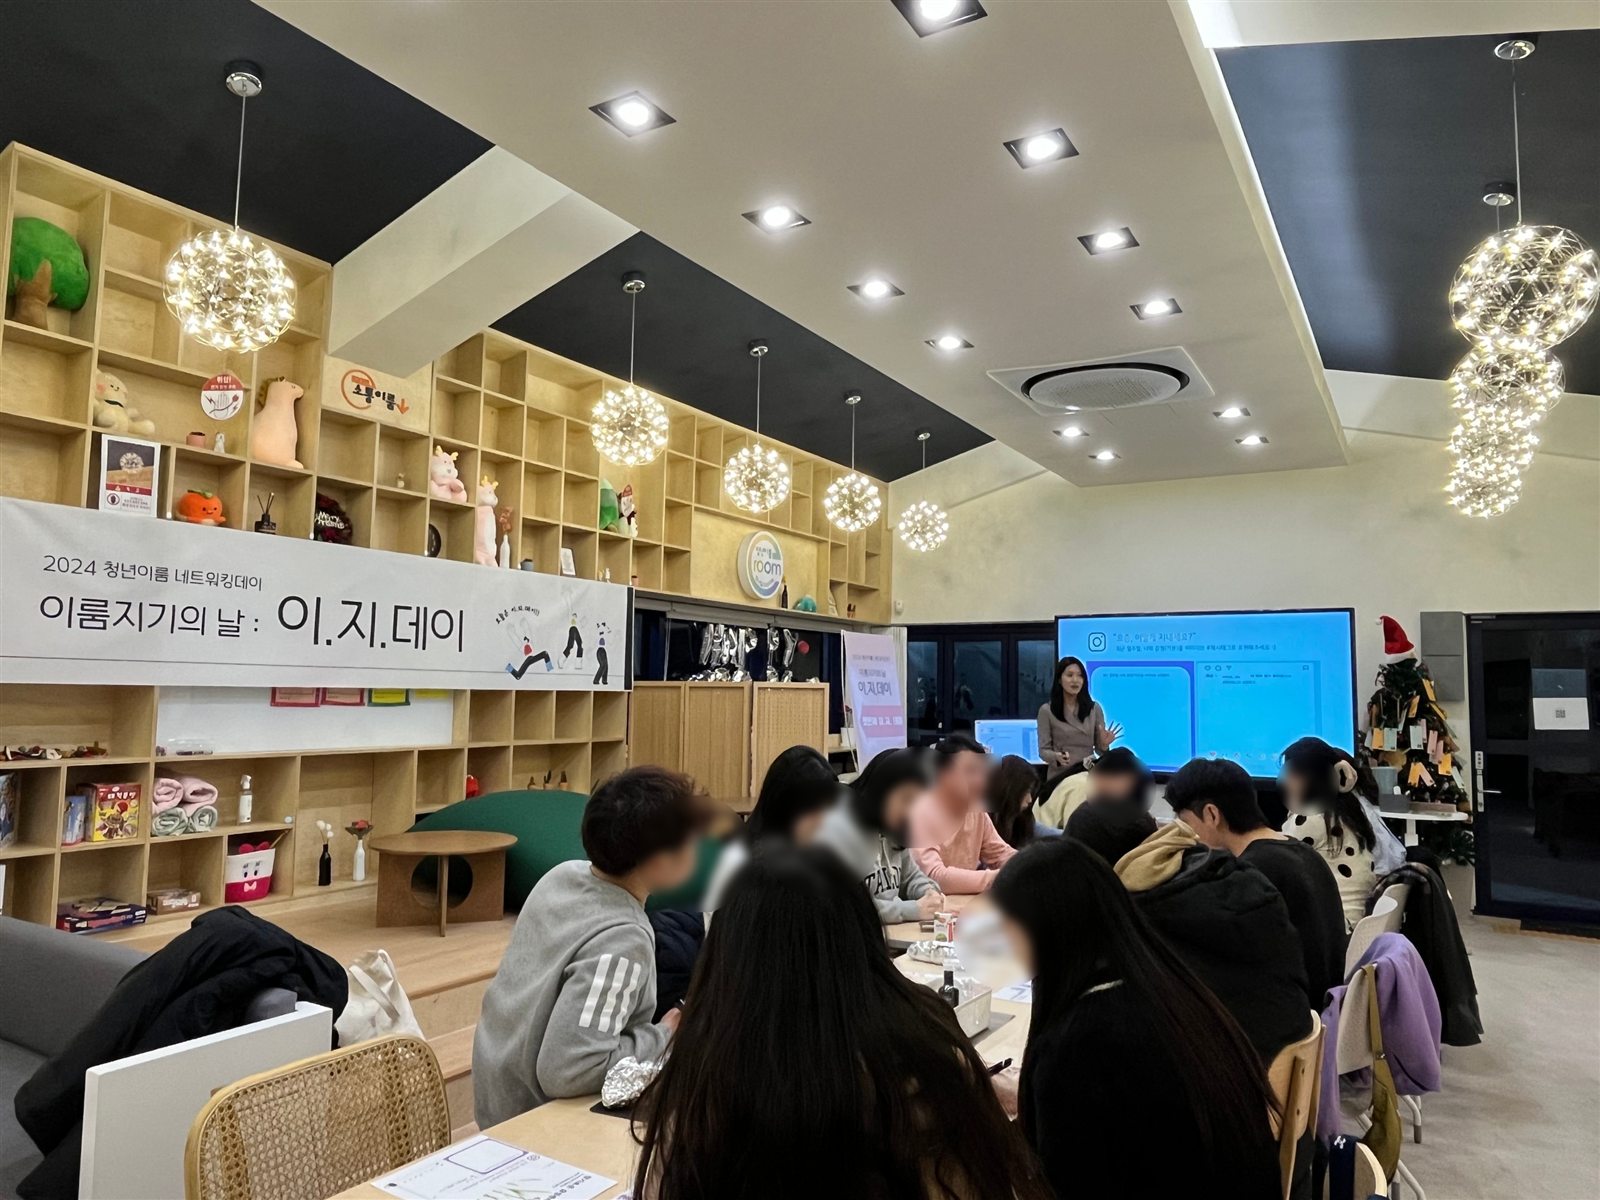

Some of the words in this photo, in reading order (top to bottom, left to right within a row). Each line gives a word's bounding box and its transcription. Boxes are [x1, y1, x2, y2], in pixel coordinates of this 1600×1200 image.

[42, 554, 97, 576] 2024
[103, 559, 169, 583] 청년이룸
[174, 567, 262, 591] 네트워킹데이
[753, 560, 782, 576] room
[39, 595, 206, 636] 이룸지기의
[277, 595, 464, 653] 이.지.데이
